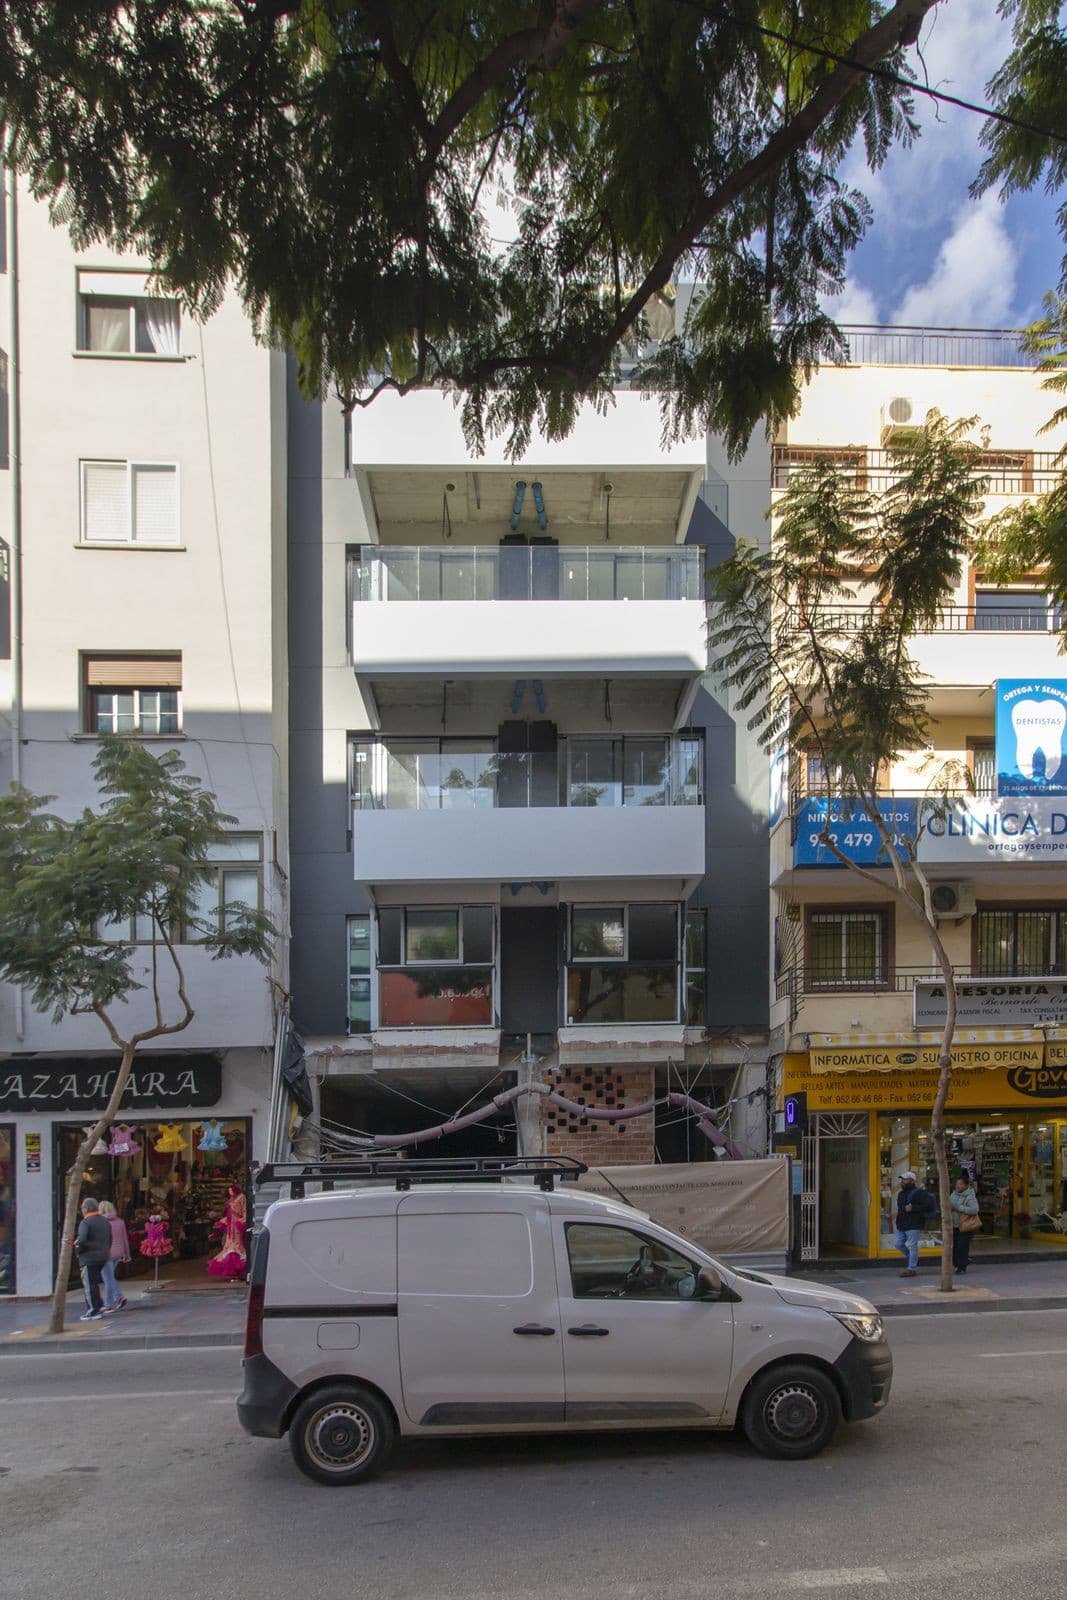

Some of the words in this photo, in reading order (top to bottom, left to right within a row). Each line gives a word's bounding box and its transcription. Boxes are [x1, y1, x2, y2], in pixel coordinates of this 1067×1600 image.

[1003, 686, 1033, 701] ORTEGA
[849, 813, 856, 821] Y
[927, 813, 1039, 836] CLINICA
[844, 833, 873, 847] 479
[814, 1055, 890, 1066] INFORMATICA
[994, 1051, 1039, 1061] OFICINA
[0, 1070, 199, 1099] AZAHARA
[801, 1082, 823, 1090] BELLAS
[826, 1082, 845, 1090] ARTES
[851, 1080, 903, 1089] MANUALIDADES
[836, 1095, 849, 1104] 952
